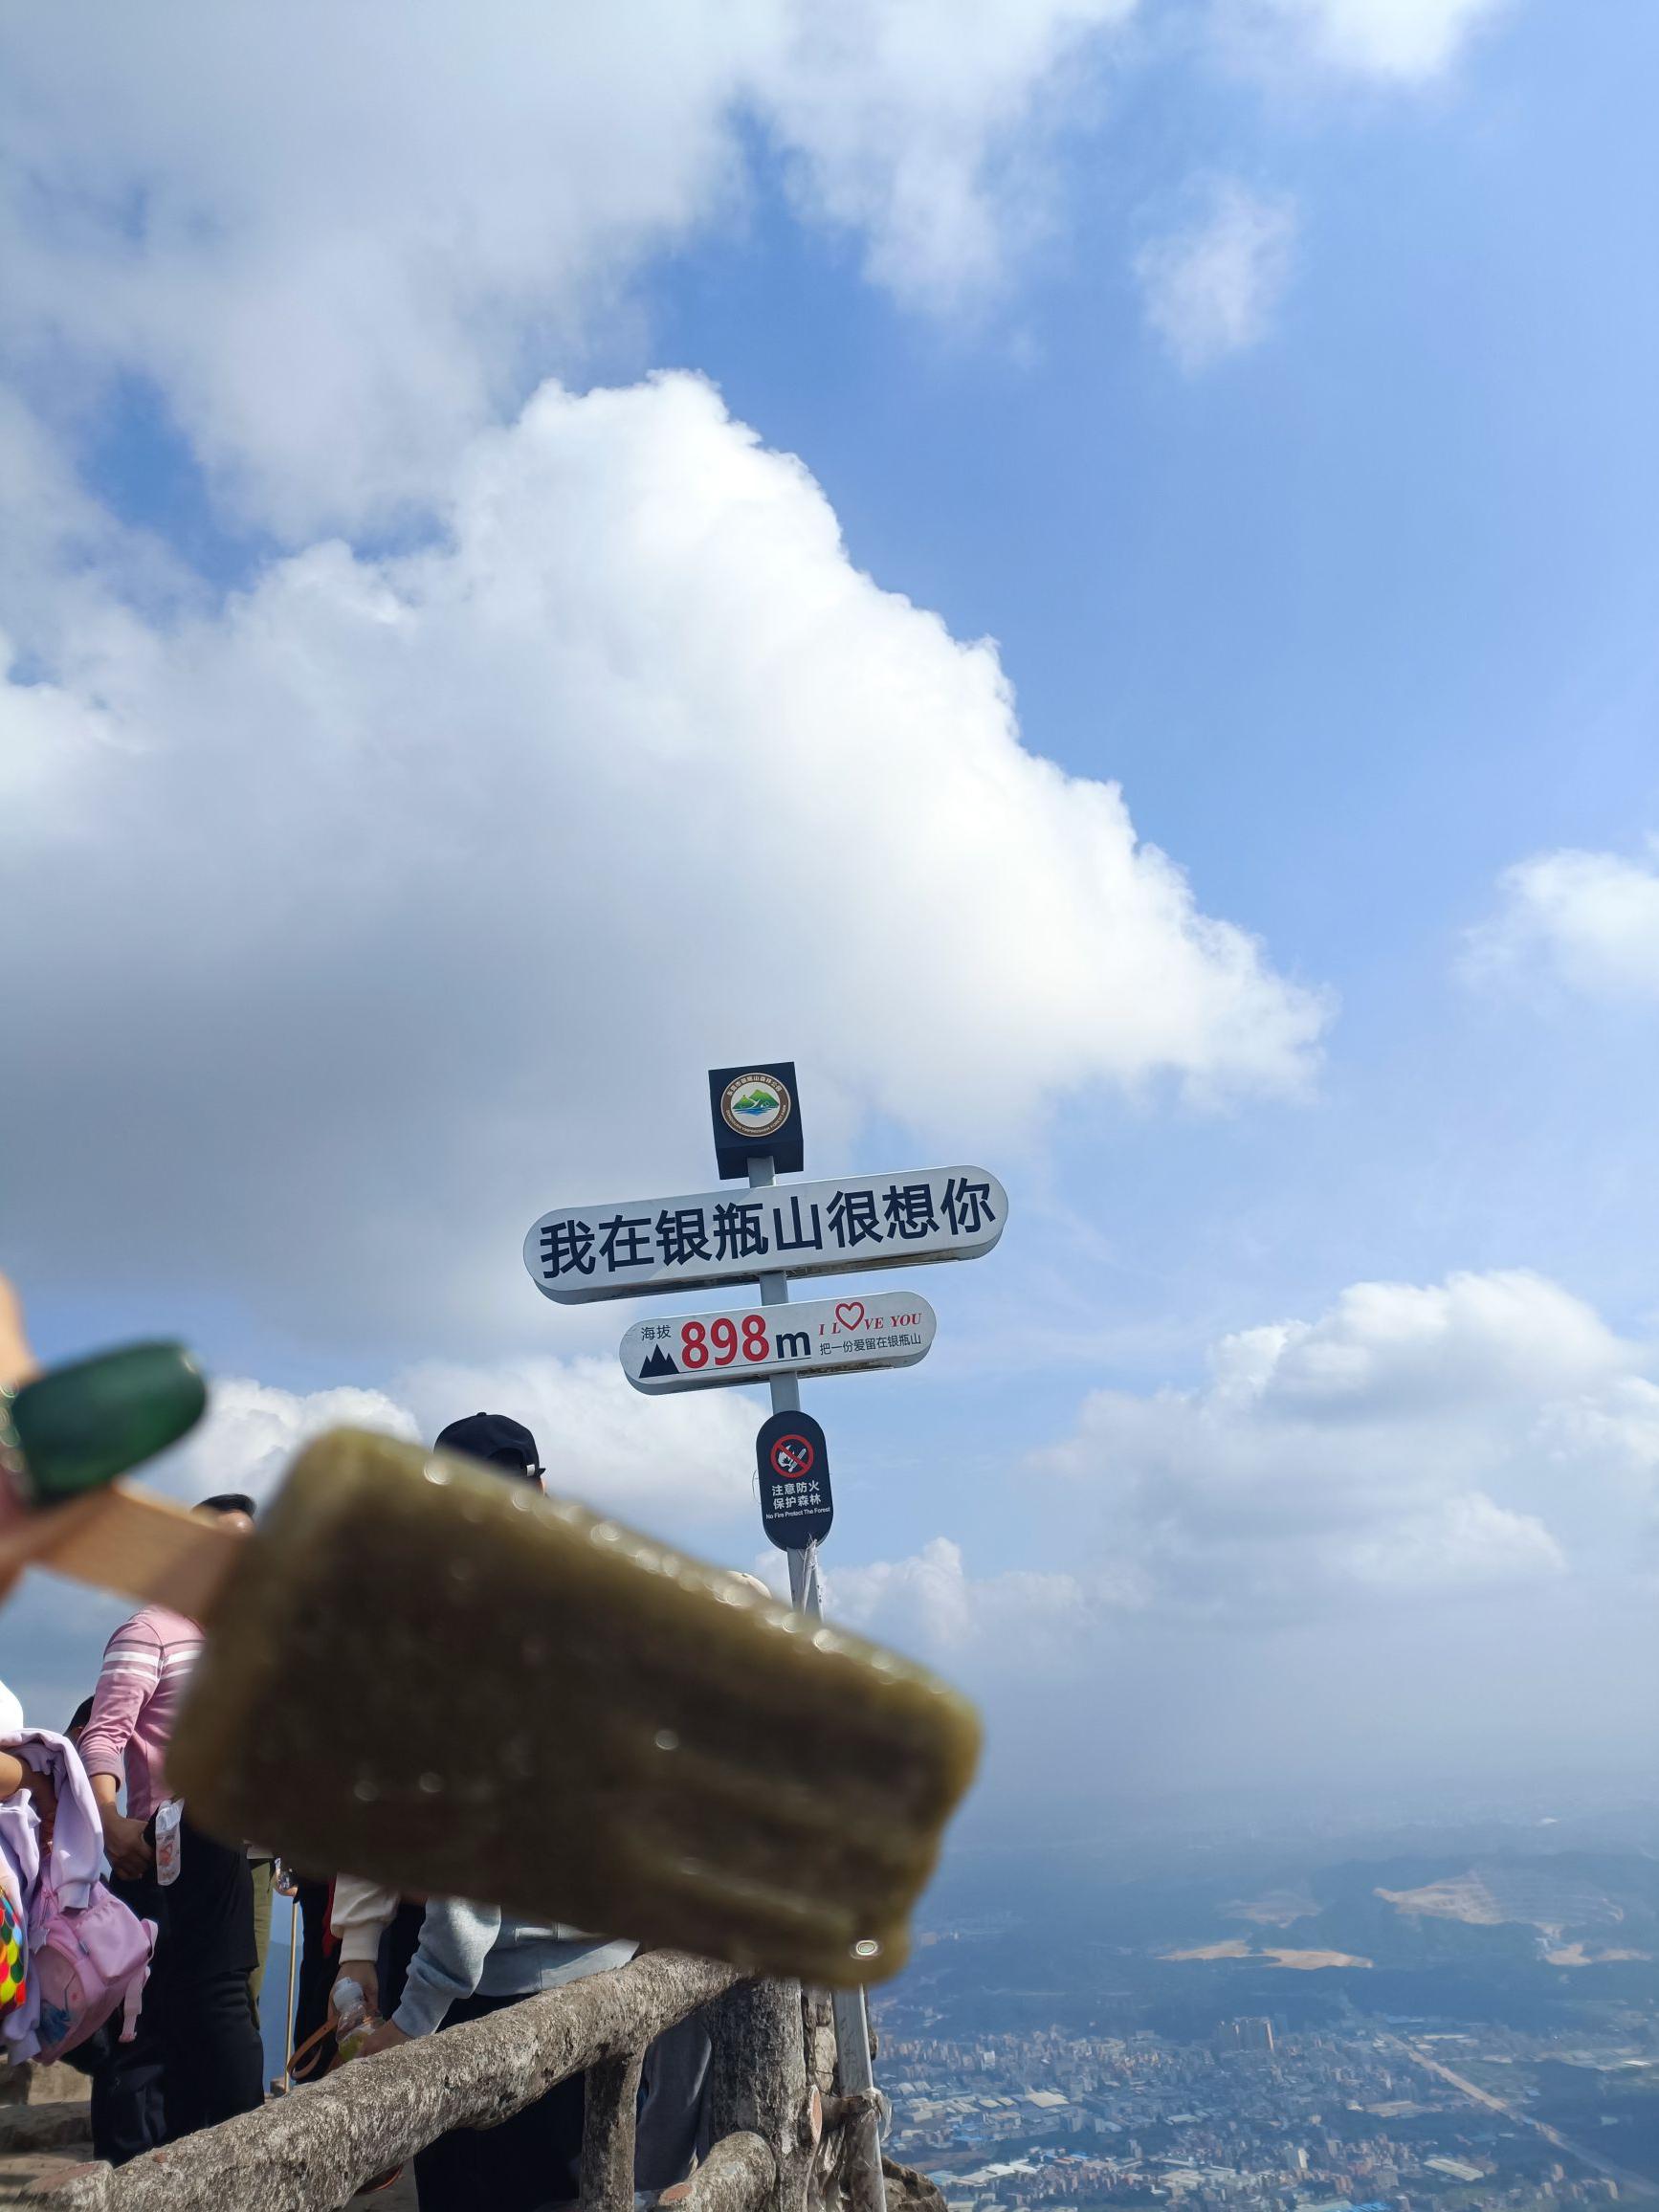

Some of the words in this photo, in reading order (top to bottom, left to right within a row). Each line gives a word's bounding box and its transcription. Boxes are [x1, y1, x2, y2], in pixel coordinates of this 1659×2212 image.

[540, 1177, 996, 1279] 我在银瓶山很想你
[890, 1313, 922, 1328] YOU
[640, 1324, 672, 1341] 海拔
[819, 1333, 921, 1356] 把一份爱留在银瓶山
[771, 1479, 820, 1496] 注意防火
[773, 1493, 821, 1511] 保护森林
